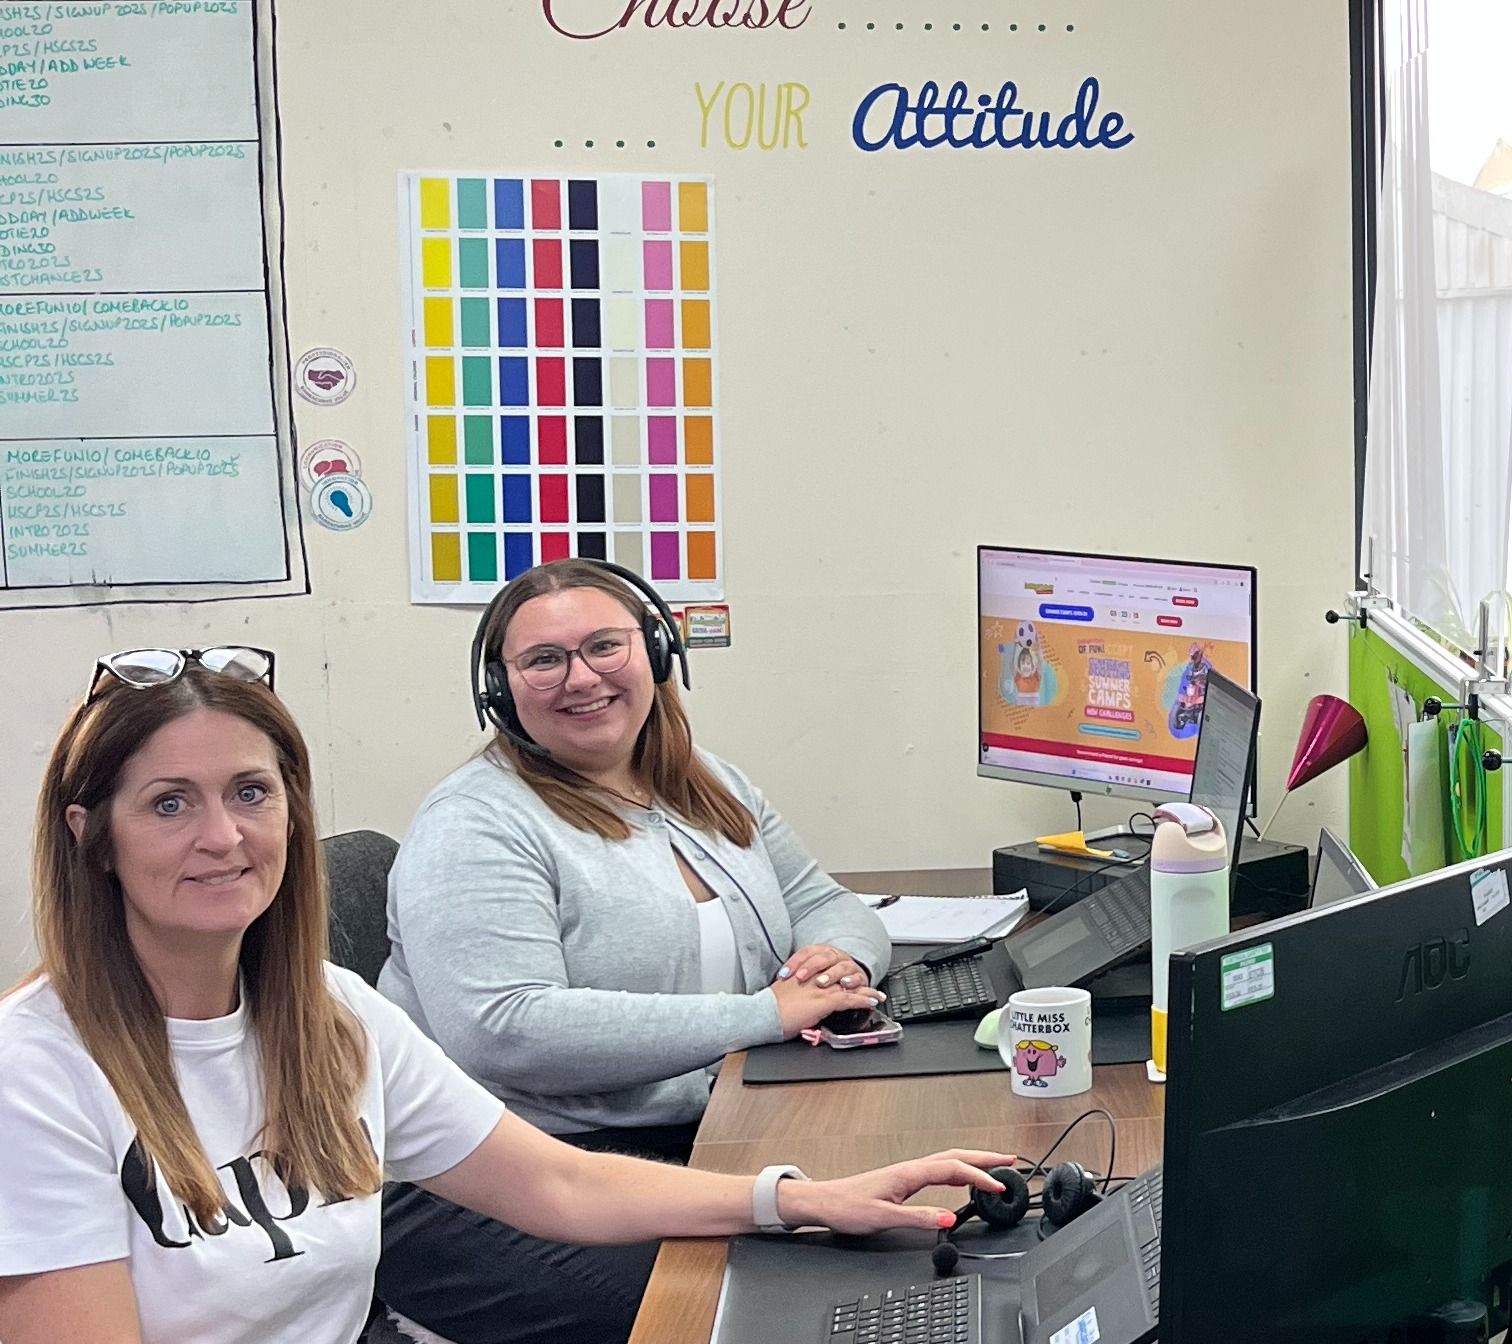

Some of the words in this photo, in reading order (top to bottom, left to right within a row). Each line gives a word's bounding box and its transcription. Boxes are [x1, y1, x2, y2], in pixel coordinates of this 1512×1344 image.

[694, 80, 811, 151] YOUR
[852, 76, 1135, 152] Attitude
[1088, 675, 1131, 693] SUMMER
[1088, 688, 1132, 710] CAMPS
[1396, 927, 1472, 1003] AOC
[1011, 1011, 1034, 1023] LITTLE
[1037, 1013, 1066, 1024] MISS
